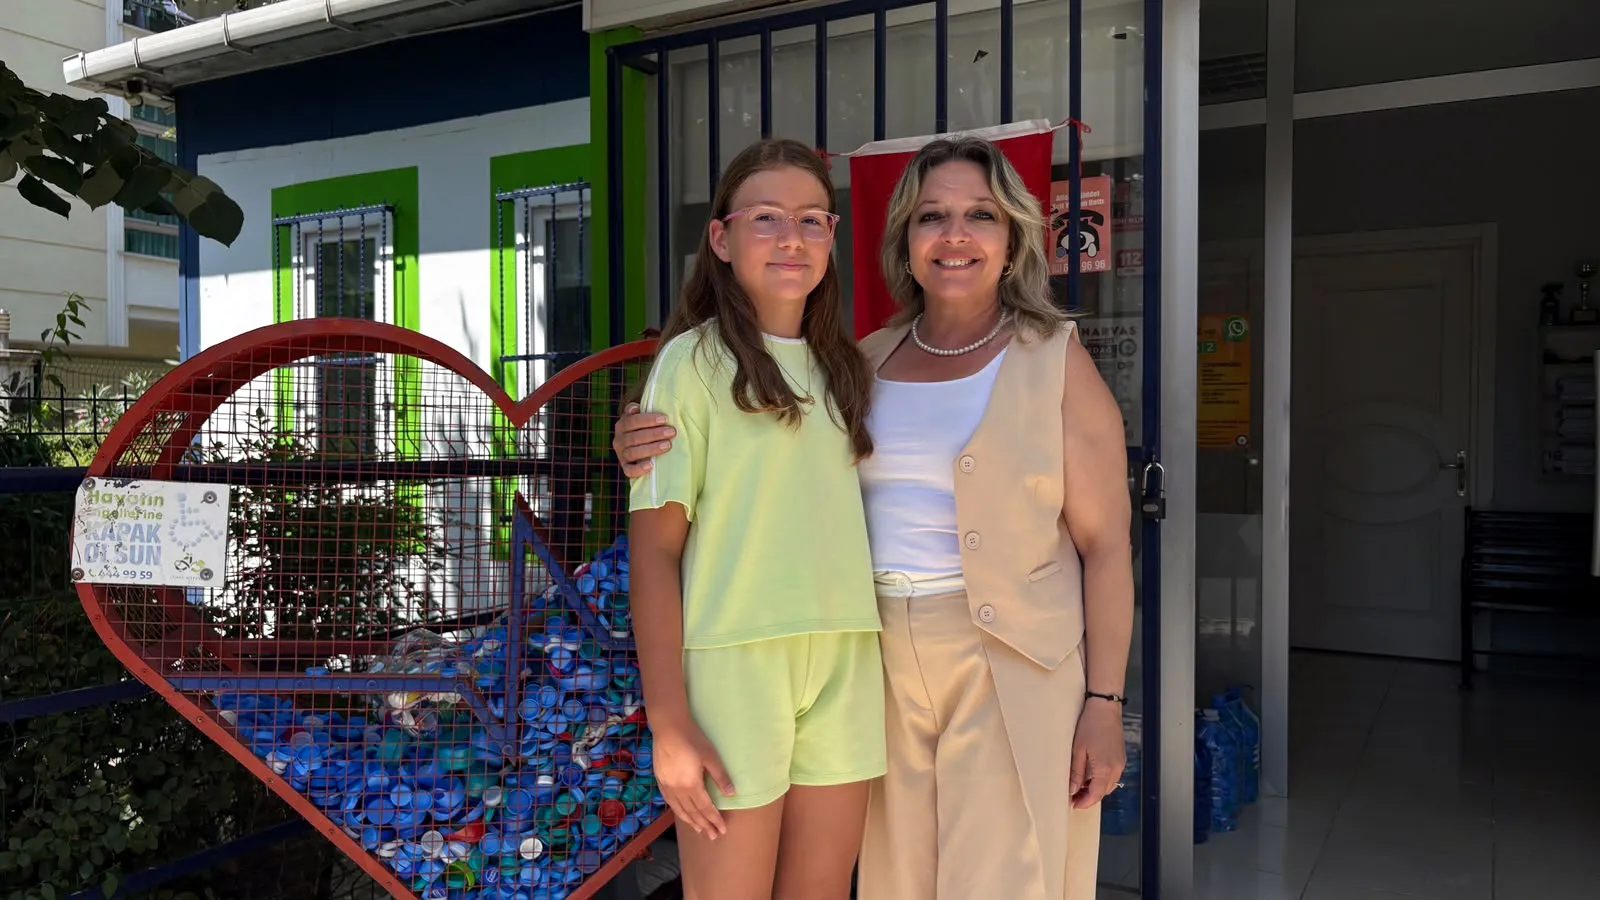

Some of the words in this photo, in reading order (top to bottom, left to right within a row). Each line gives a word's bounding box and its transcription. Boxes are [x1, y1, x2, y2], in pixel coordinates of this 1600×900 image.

[1120, 252, 1142, 266] 112
[86, 520, 162, 544] KAPAK
[84, 542, 162, 566] OLSUN
[122, 570, 136, 579] 99
[139, 570, 153, 580] 59
